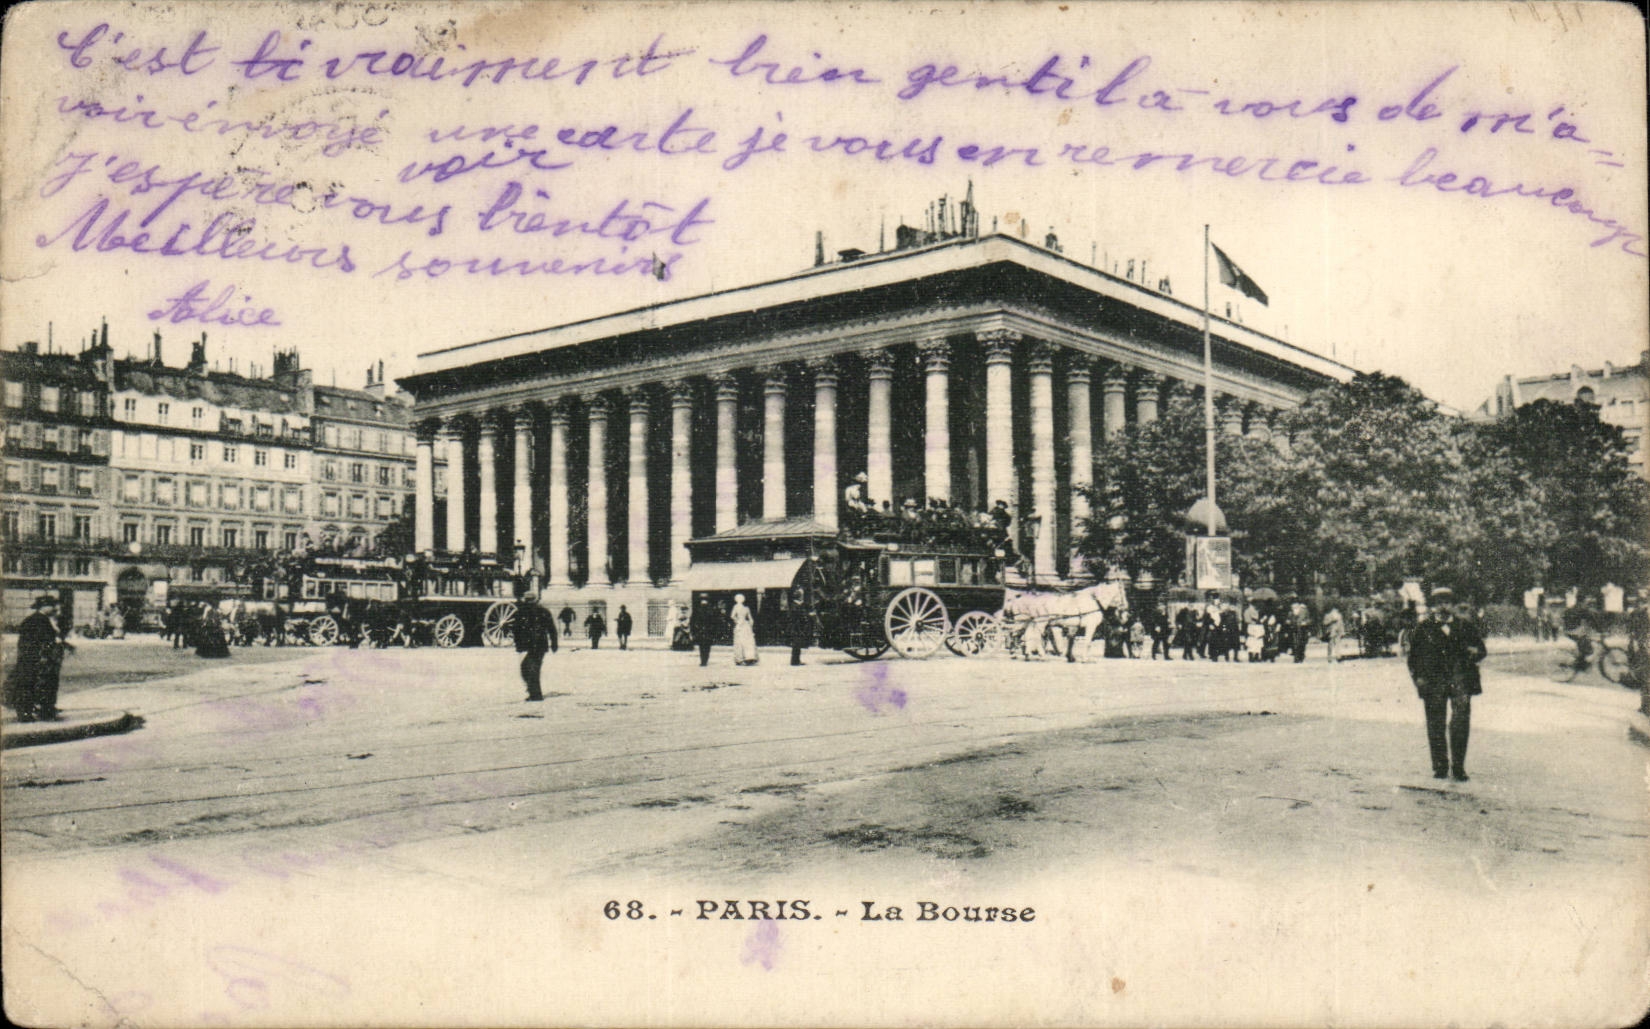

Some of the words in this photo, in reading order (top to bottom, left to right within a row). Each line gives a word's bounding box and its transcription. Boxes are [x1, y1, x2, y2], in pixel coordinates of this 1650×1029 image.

[56, 22, 222, 76] C'est
[321, 33, 697, 88] vraiment
[708, 34, 882, 85] bien
[896, 55, 1152, 108] gentil
[1213, 94, 1359, 123] vous
[1377, 65, 1460, 122] de
[57, 95, 165, 129] voir
[428, 124, 538, 144] une
[556, 108, 717, 155] carte
[722, 111, 787, 171] je
[801, 133, 944, 165] vous
[957, 144, 1044, 168] en
[1056, 142, 1372, 185] remercie
[398, 138, 574, 184] voir
[35, 197, 356, 273] Meilleurs
[372, 245, 684, 283] souvenirs
[314, 188, 453, 237] vous
[478, 180, 716, 246] bientôt
[147, 279, 282, 327] Alice
